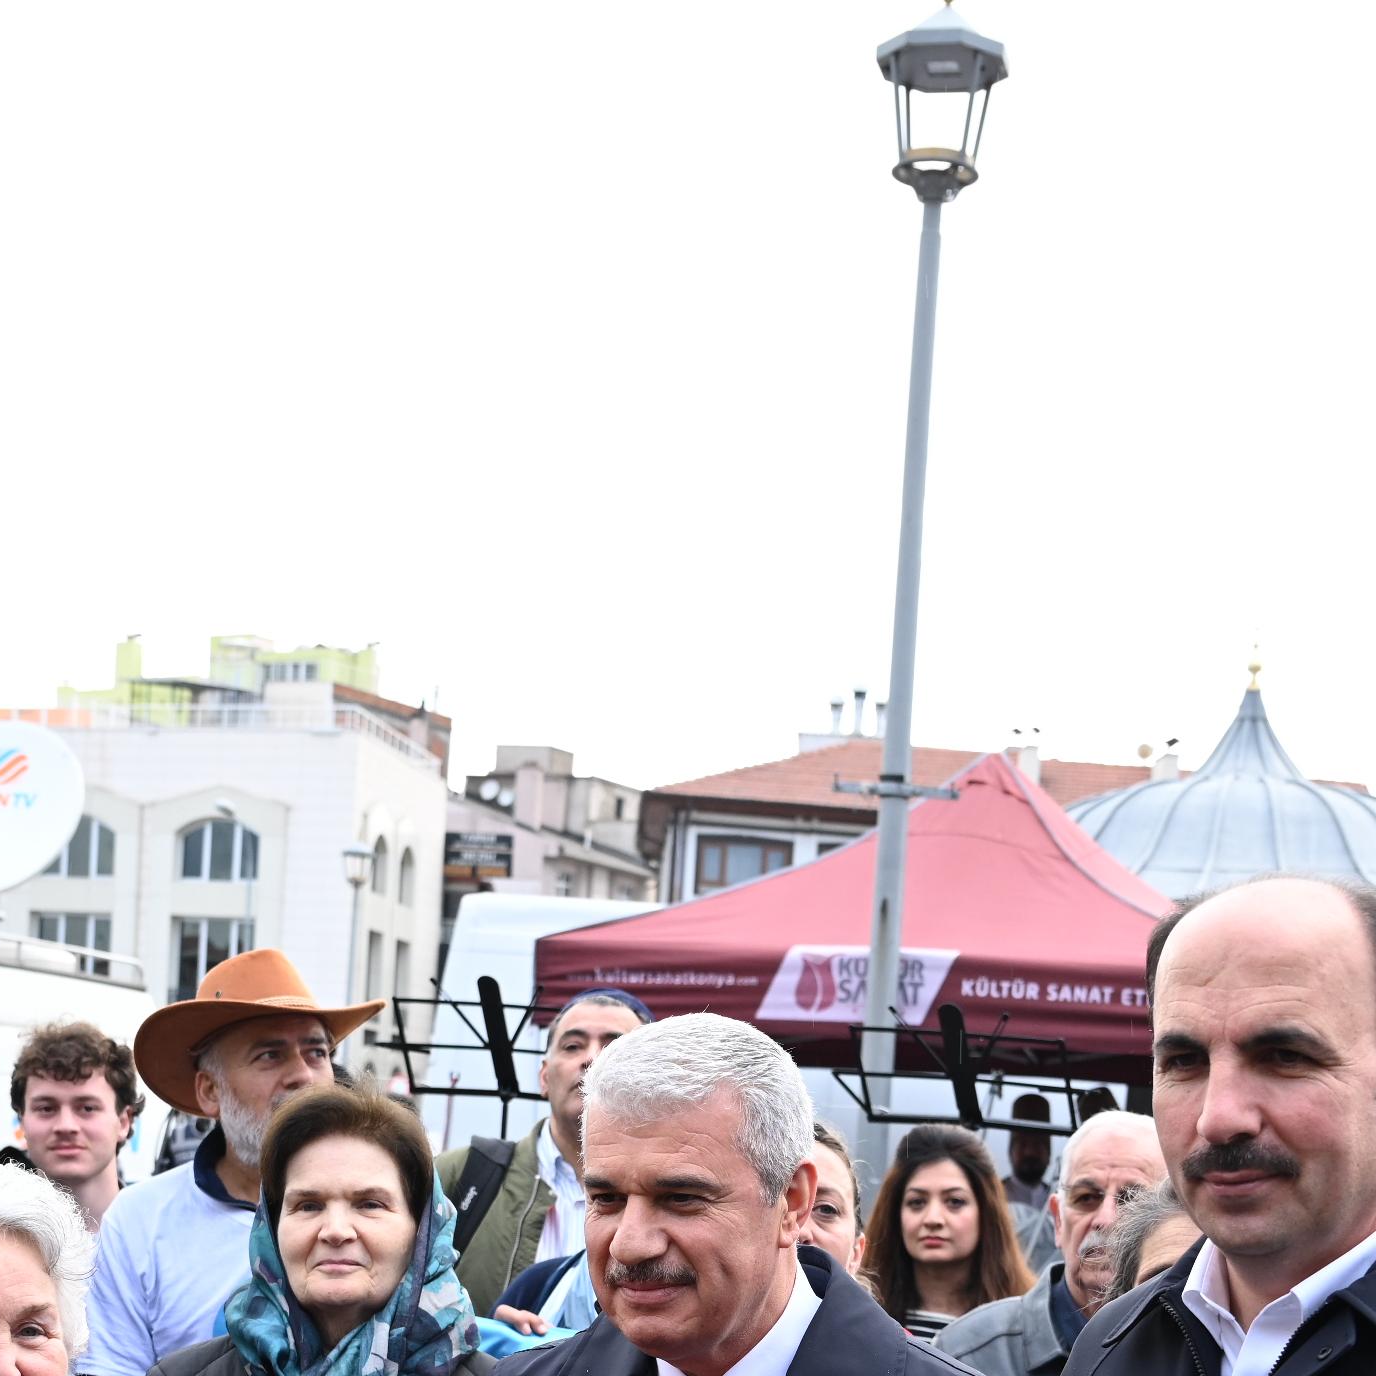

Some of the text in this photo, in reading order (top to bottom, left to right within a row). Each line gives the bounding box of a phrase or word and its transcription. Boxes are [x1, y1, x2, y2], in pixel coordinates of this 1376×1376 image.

[838, 979, 924, 1006] SAAT
[961, 976, 1040, 1000] KÜLTÜR
[1046, 983, 1114, 1004] SANAT
